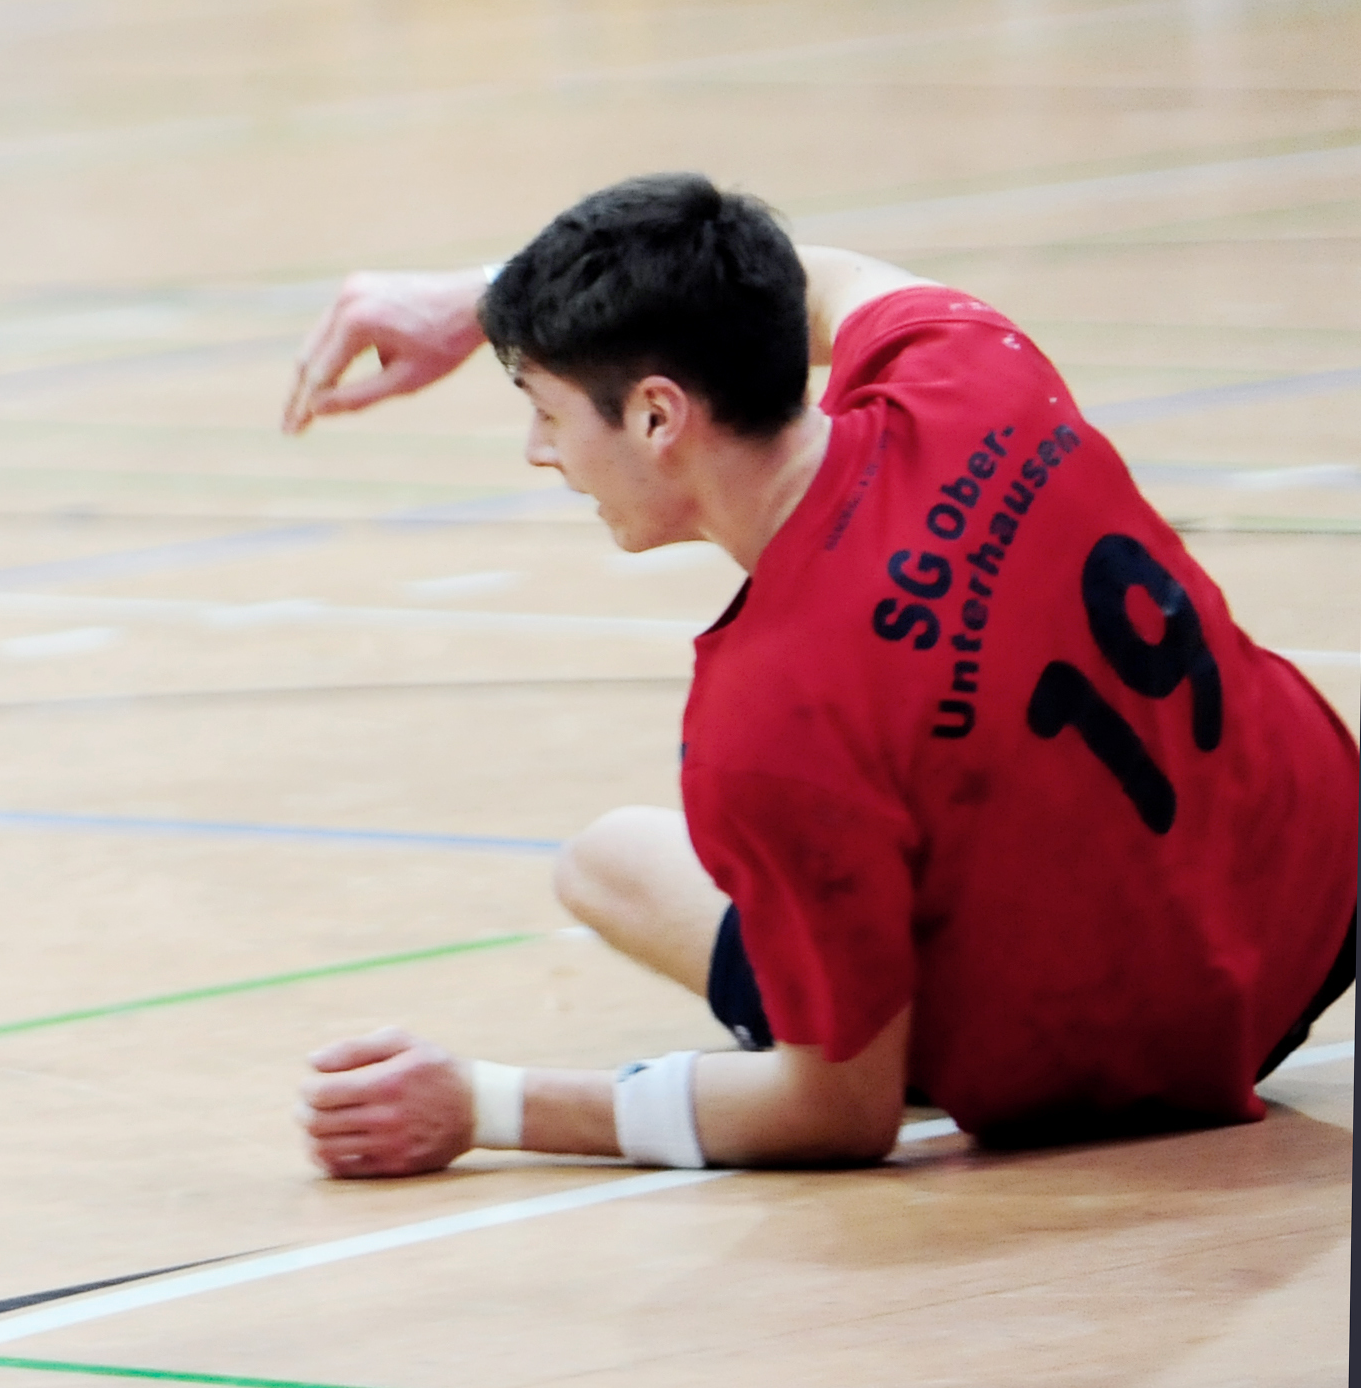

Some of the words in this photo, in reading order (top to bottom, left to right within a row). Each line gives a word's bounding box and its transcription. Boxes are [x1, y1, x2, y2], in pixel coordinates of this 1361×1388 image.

[872, 548, 954, 651] SG
[930, 423, 1082, 740] Unterhausen
[1027, 532, 1224, 836] 19
